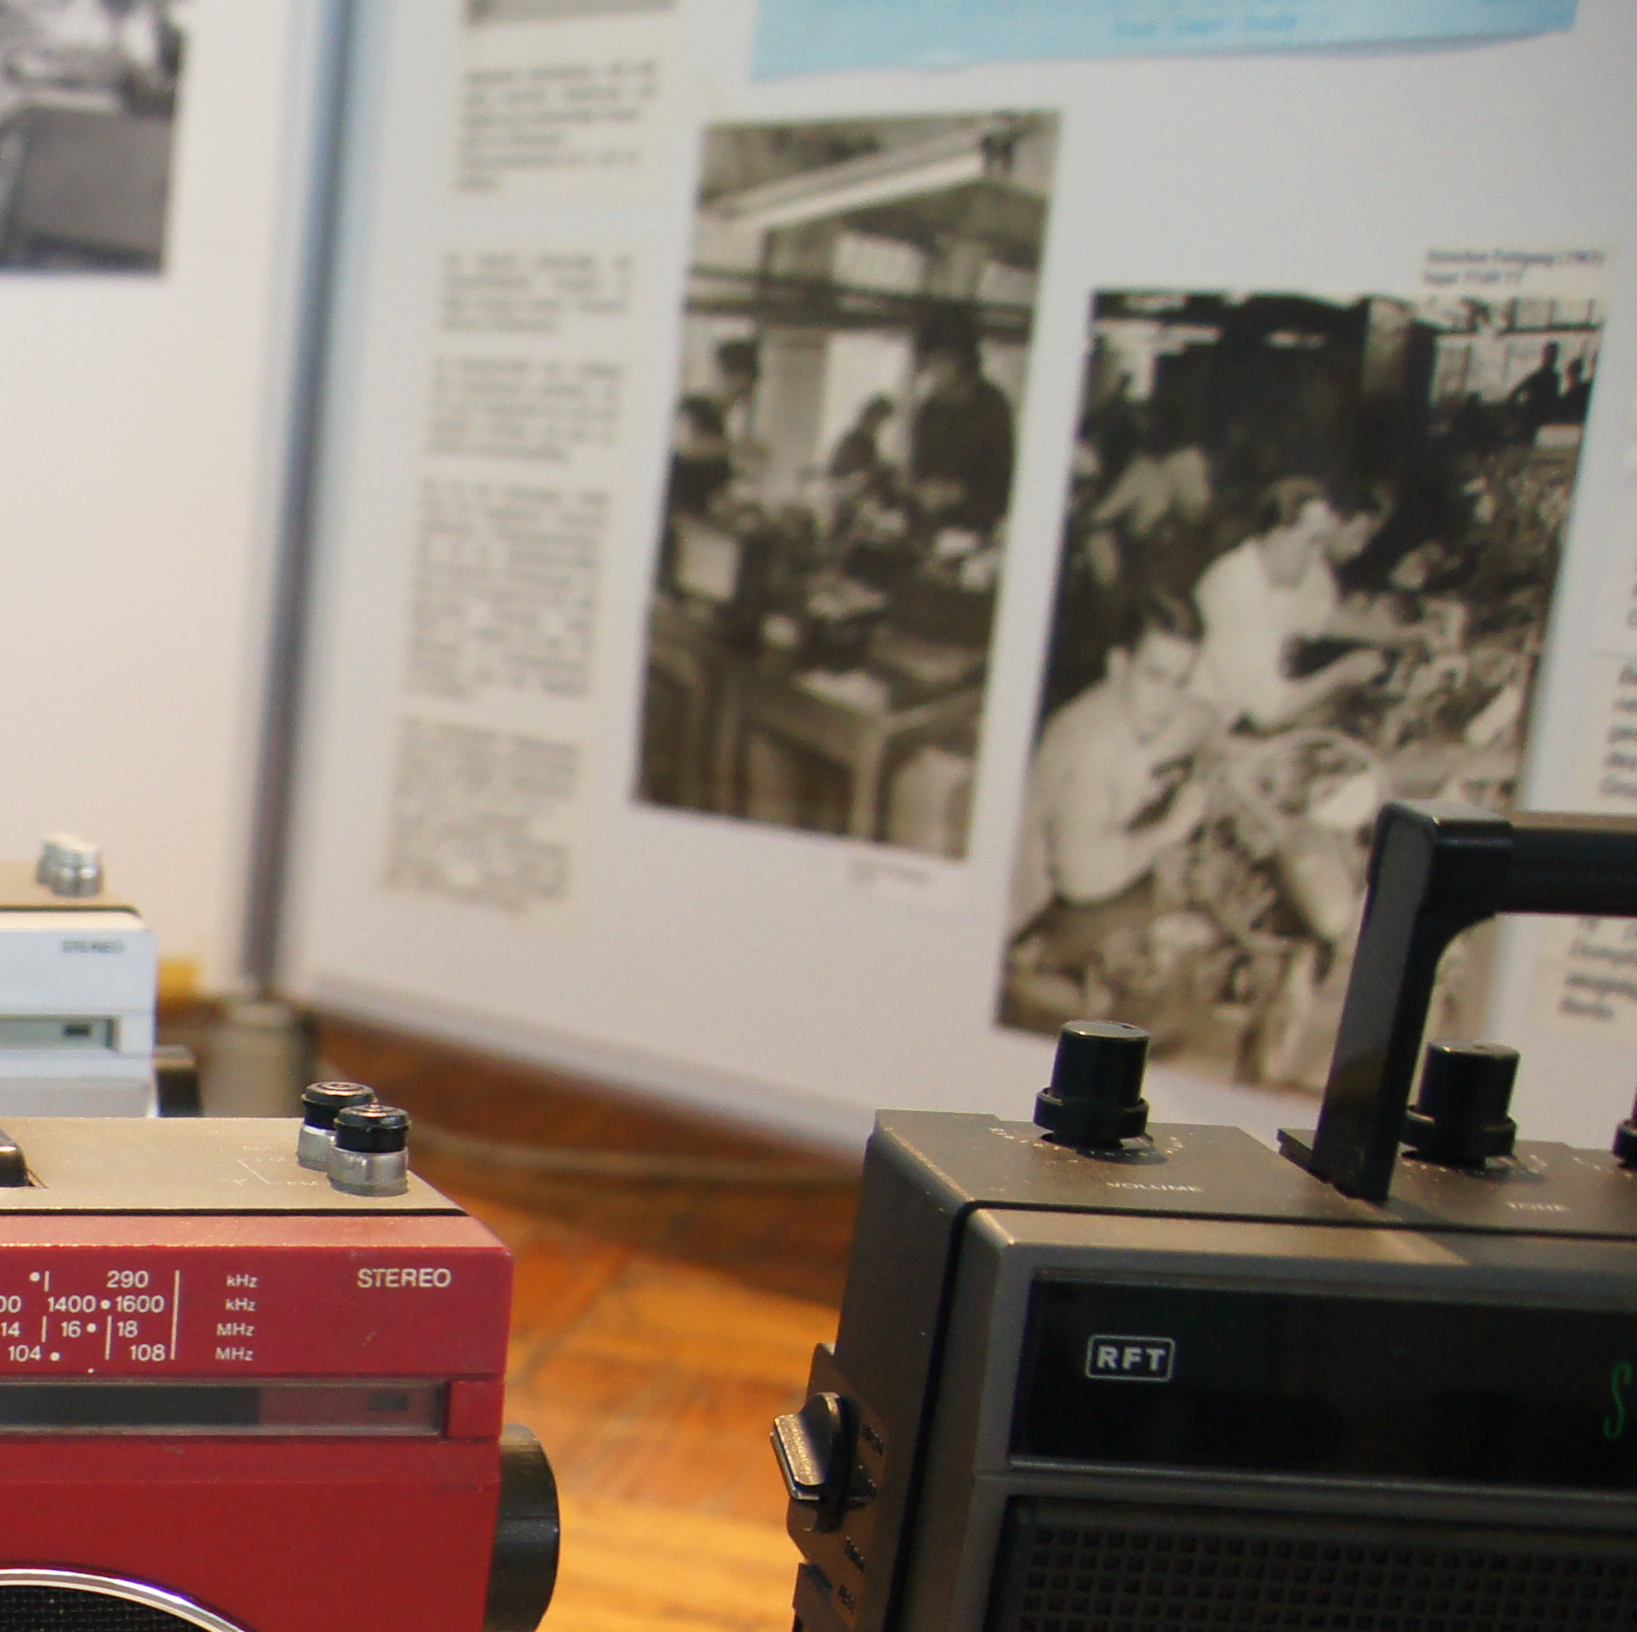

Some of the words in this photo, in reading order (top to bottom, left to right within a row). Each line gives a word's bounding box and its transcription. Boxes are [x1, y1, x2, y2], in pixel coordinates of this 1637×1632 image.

[106, 1270, 150, 1289] 290
[226, 1273, 259, 1289] kHz
[357, 1267, 452, 1289] STEREO
[47, 1294, 97, 1314] 1400
[115, 1294, 165, 1314] 1600
[225, 1297, 256, 1312] kHz
[0, 1321, 21, 1338] 14
[60, 1320, 82, 1339] 16
[116, 1319, 139, 1339] 18
[216, 1322, 255, 1337] MHz
[8, 1344, 42, 1363] 104
[130, 1343, 166, 1362] 108
[215, 1346, 254, 1362] MHz
[1096, 1345, 1168, 1371] RFT
